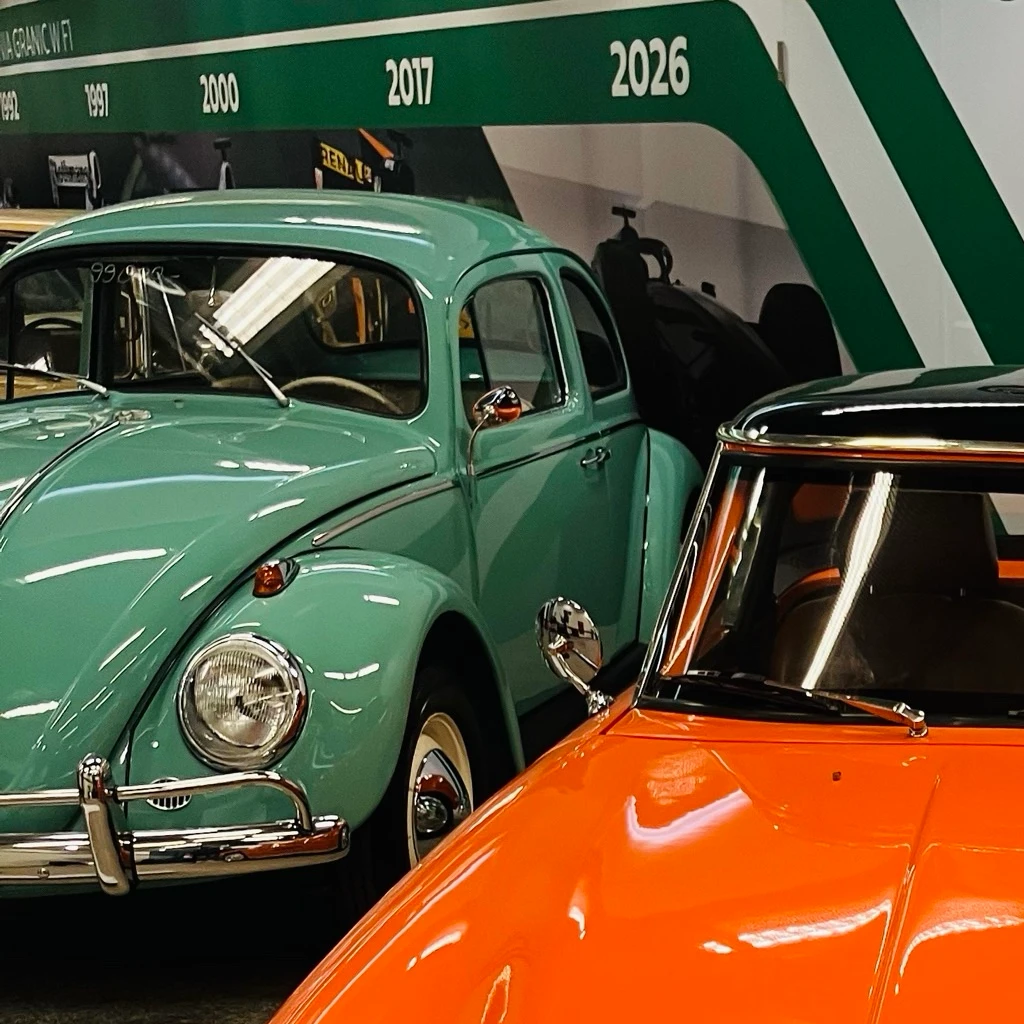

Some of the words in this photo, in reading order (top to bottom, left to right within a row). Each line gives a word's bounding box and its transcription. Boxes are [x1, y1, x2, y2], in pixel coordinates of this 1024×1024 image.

[12, 22, 51, 58] GRANIC
[48, 21, 61, 53] W
[84, 82, 109, 118] 1997
[200, 73, 240, 114] 2000
[386, 56, 434, 106] 2017
[610, 35, 690, 98] 2026
